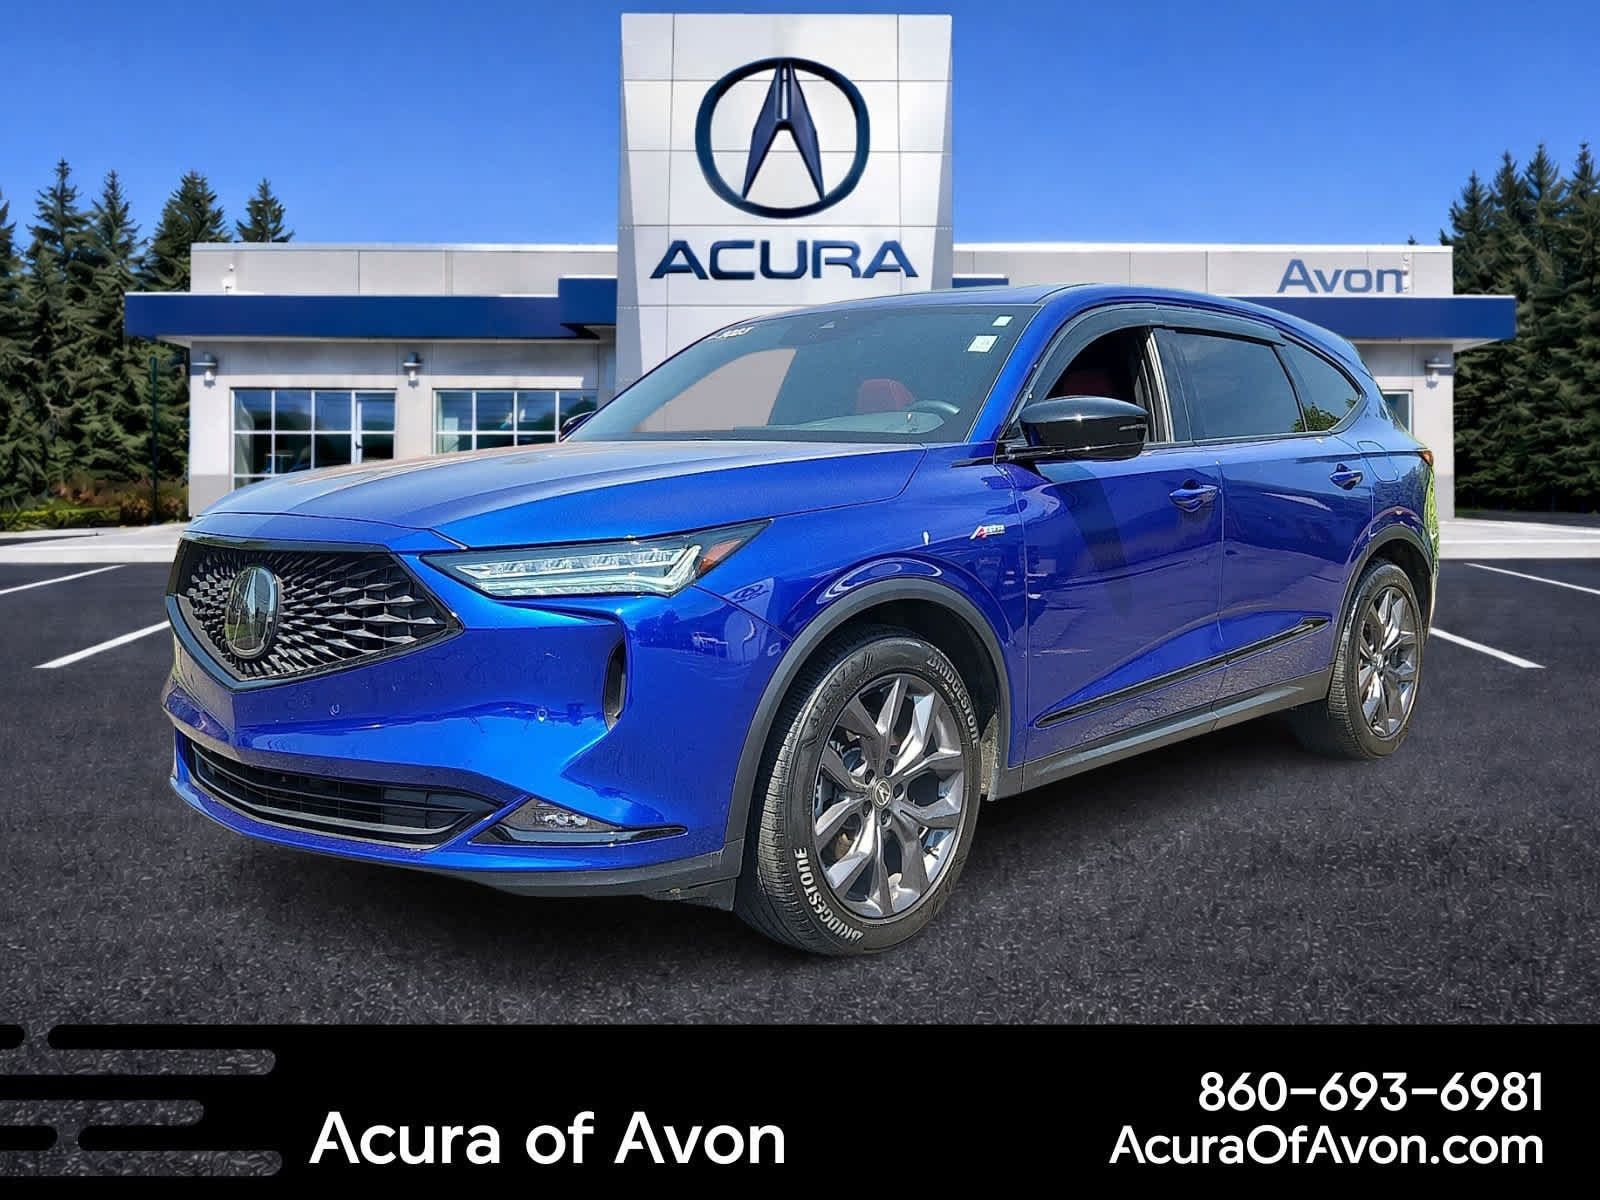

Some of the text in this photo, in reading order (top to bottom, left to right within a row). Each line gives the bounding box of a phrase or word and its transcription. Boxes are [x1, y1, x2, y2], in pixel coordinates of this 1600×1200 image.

[650, 240, 918, 280] ACURA
[1276, 258, 1404, 294] Avon
[926, 655, 980, 750] BRIDGESTONE
[793, 847, 864, 944] BRIDGESTONE
